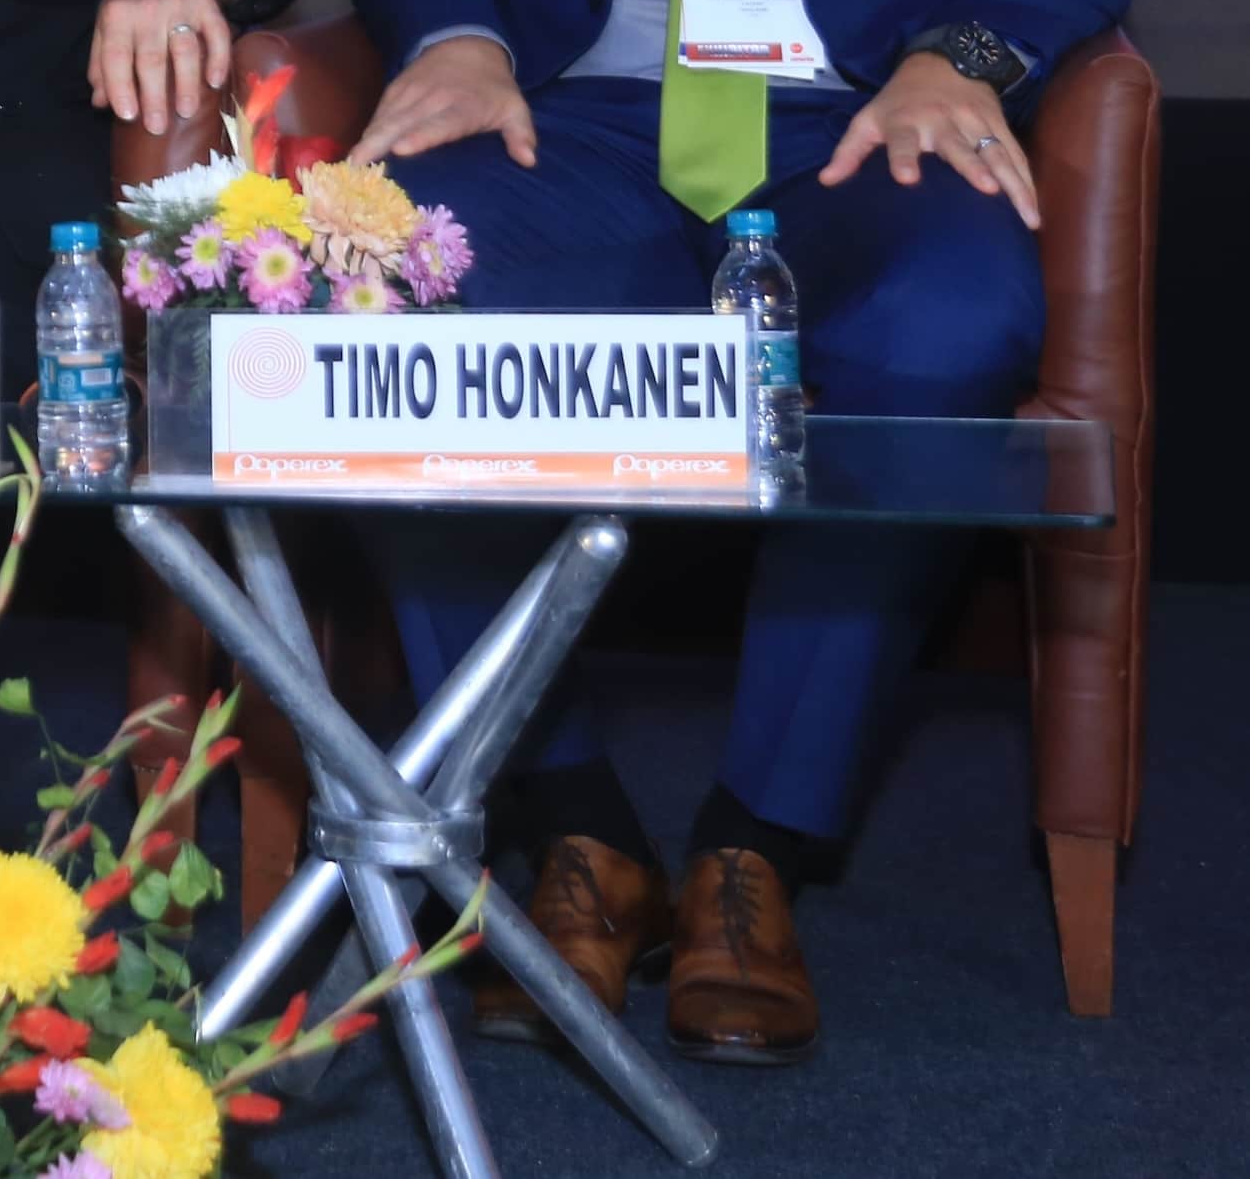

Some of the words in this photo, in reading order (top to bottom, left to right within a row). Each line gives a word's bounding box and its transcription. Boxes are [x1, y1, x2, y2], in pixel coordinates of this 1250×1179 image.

[314, 341, 438, 420] TIMO
[456, 341, 737, 420] HONKANEN
[233, 453, 348, 481] Paperex
[612, 453, 731, 482] Paperex
